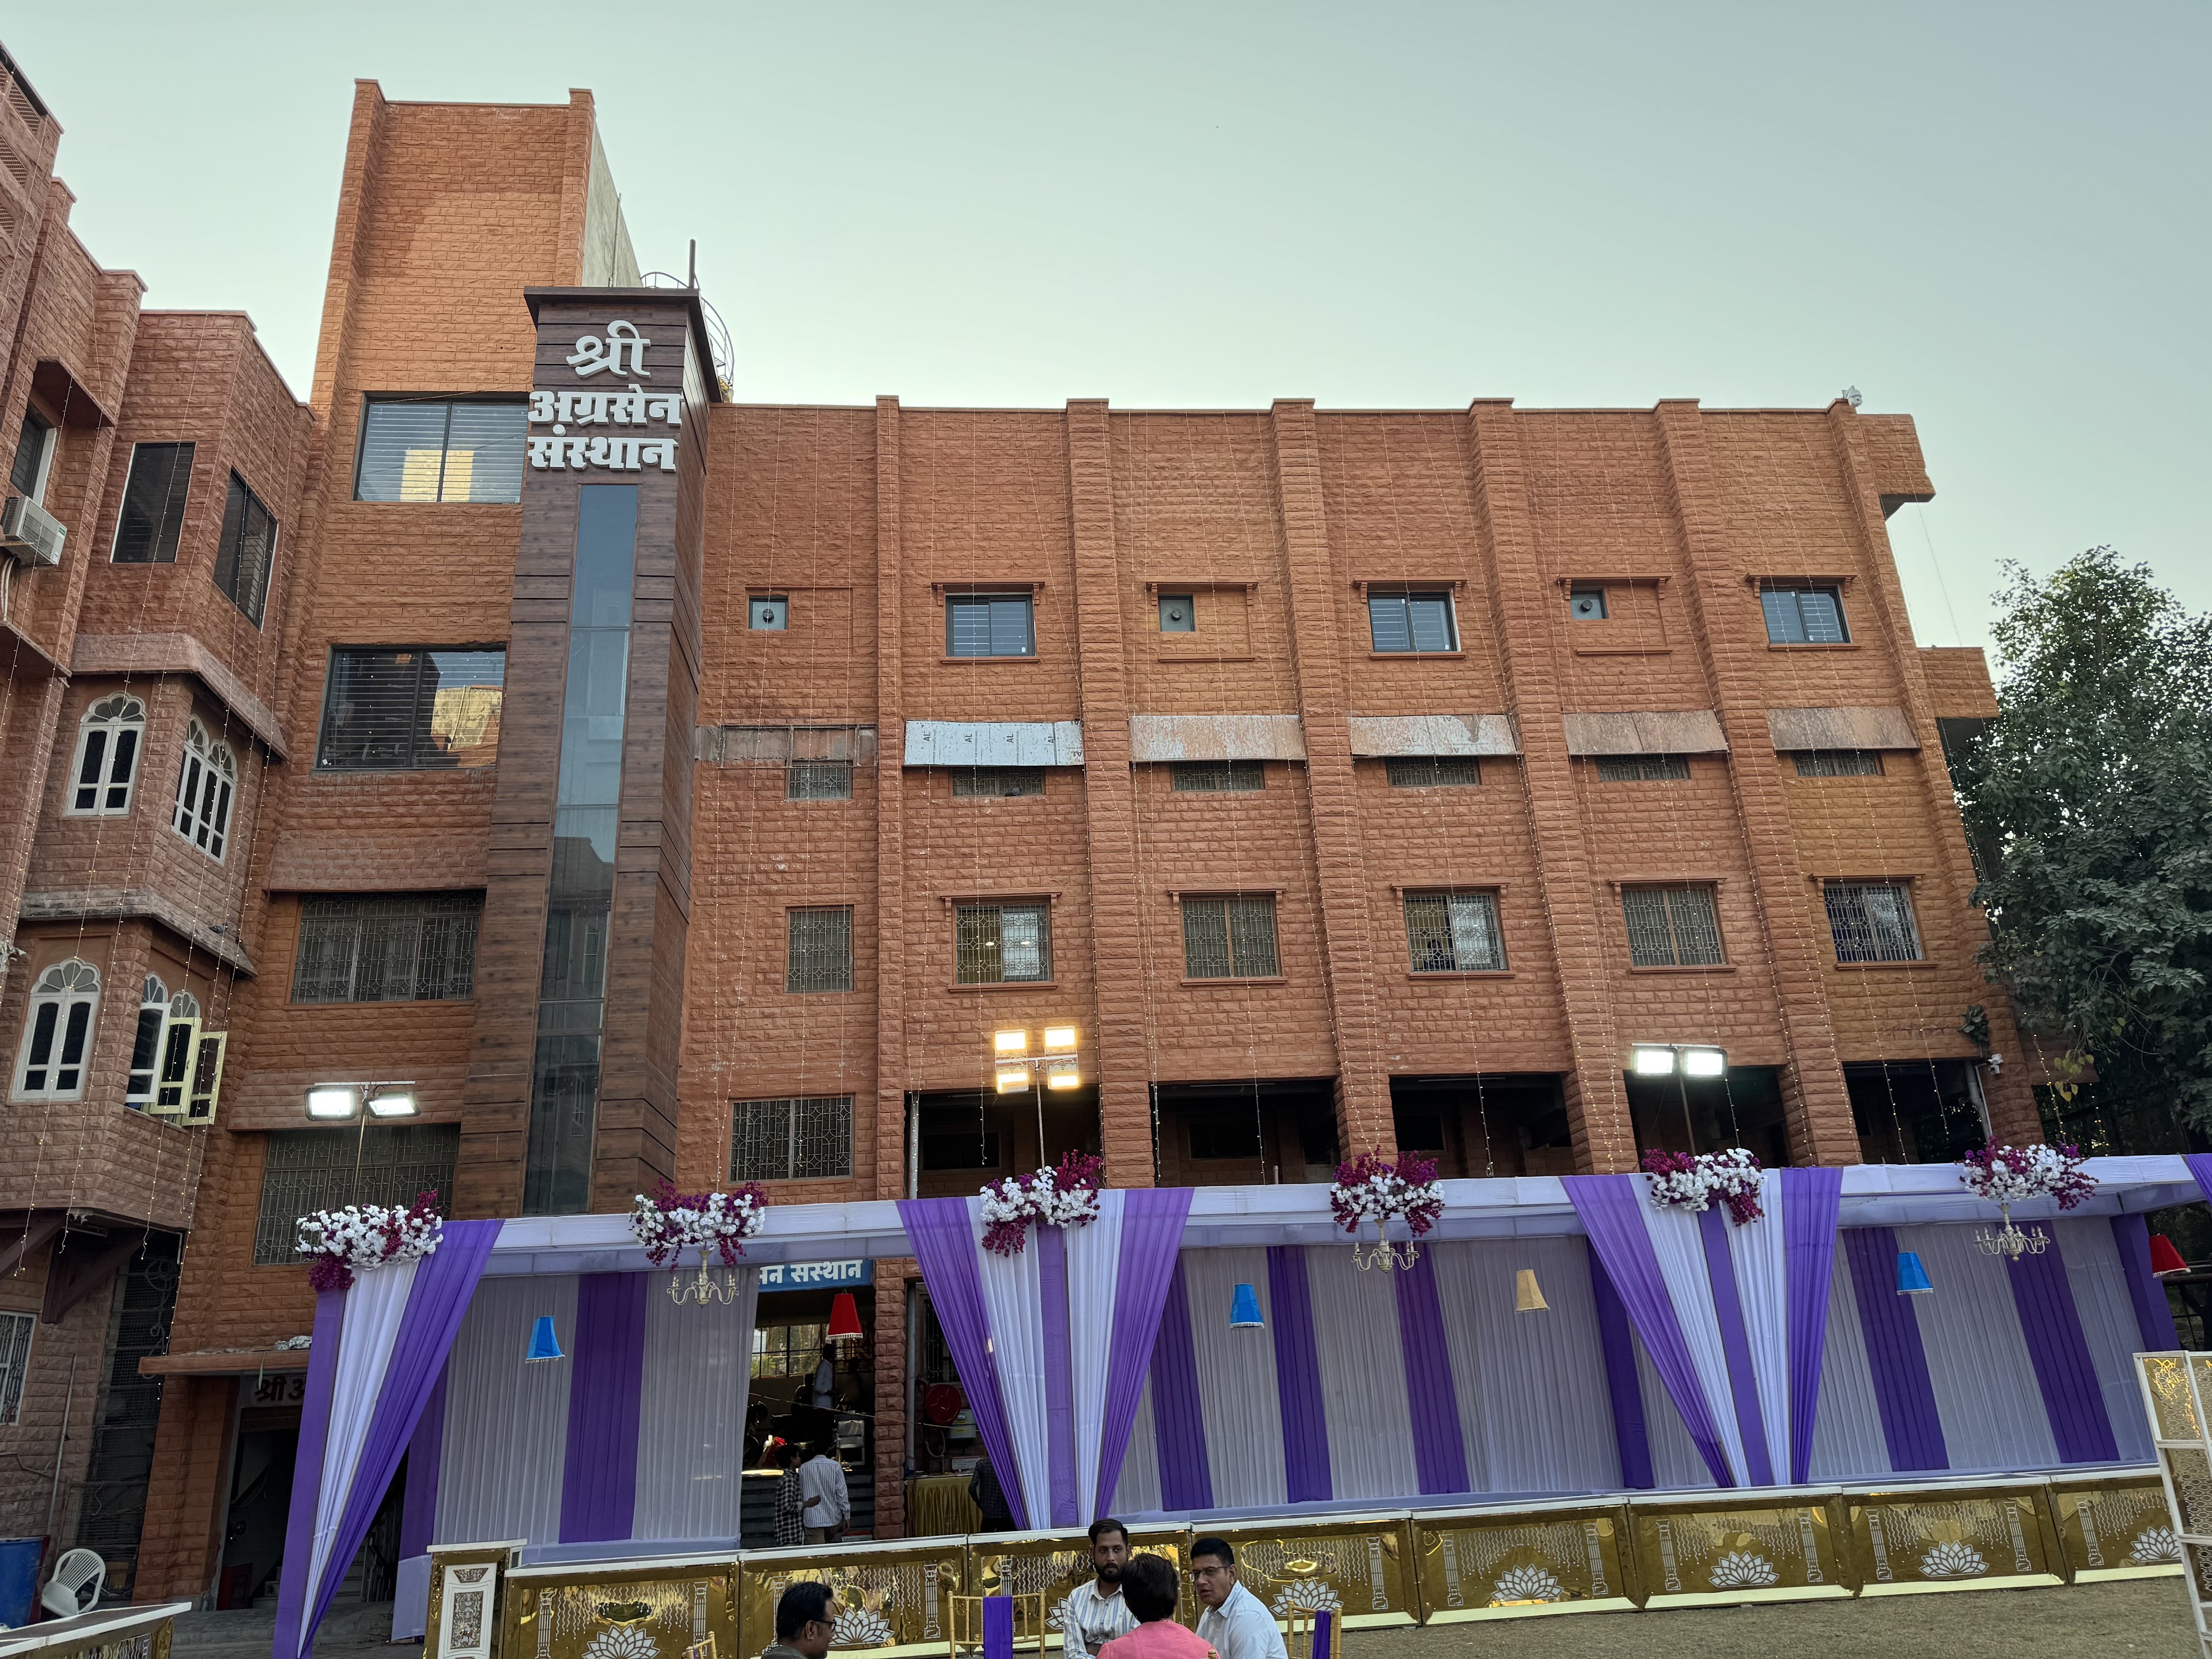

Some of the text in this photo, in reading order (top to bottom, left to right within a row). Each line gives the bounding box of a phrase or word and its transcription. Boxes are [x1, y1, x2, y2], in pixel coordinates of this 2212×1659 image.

[566, 320, 651, 378] श्री
[528, 384, 684, 427] अग्रसेन
[527, 424, 679, 472] संस्थान
[255, 1375, 287, 1401] श्री
